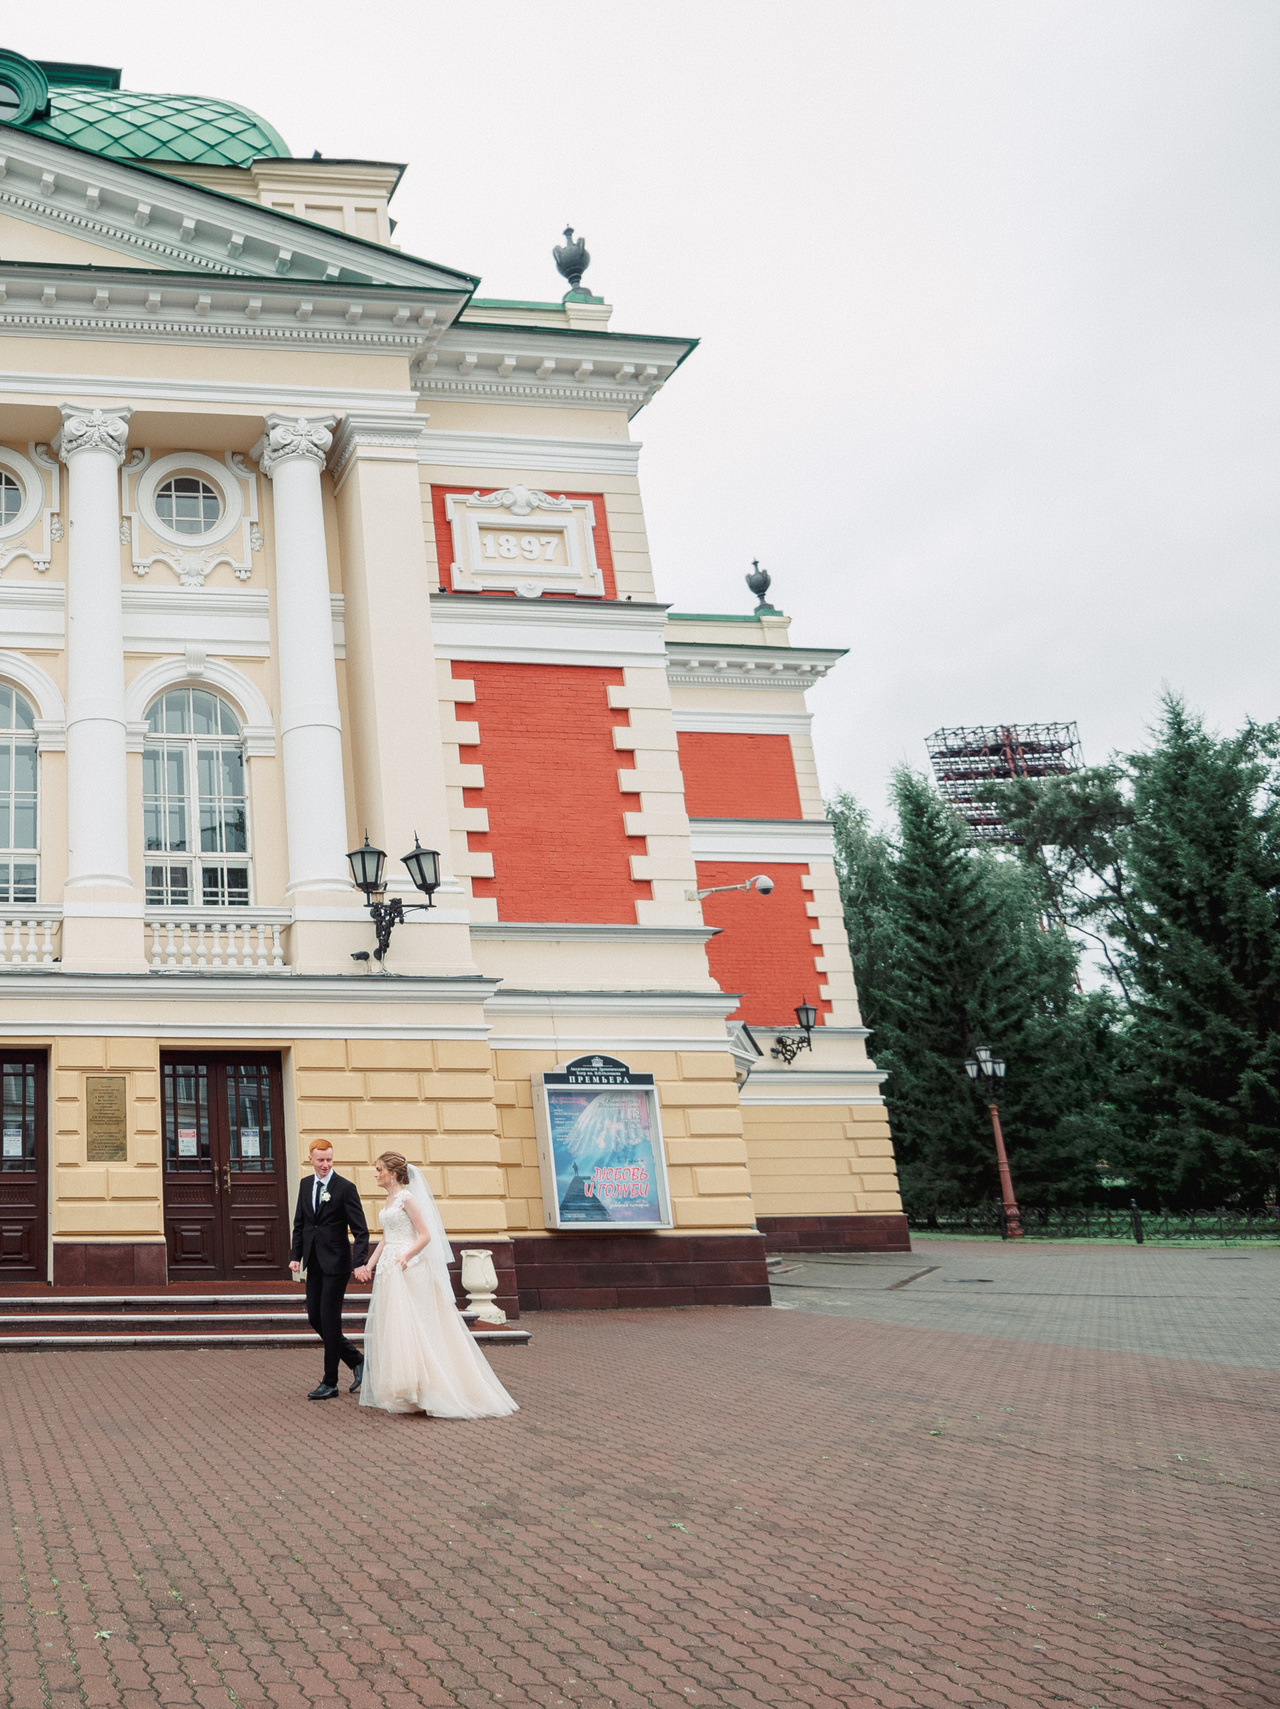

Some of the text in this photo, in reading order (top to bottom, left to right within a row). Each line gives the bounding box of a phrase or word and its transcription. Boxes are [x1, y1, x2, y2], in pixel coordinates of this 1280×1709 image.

[482, 534, 558, 560] 1897
[568, 1076, 630, 1084] ПРЕМЬЕРА
[591, 1166, 649, 1182] ЛЮБОВЬ
[584, 1182, 649, 1198] И ГОЛУБИ
